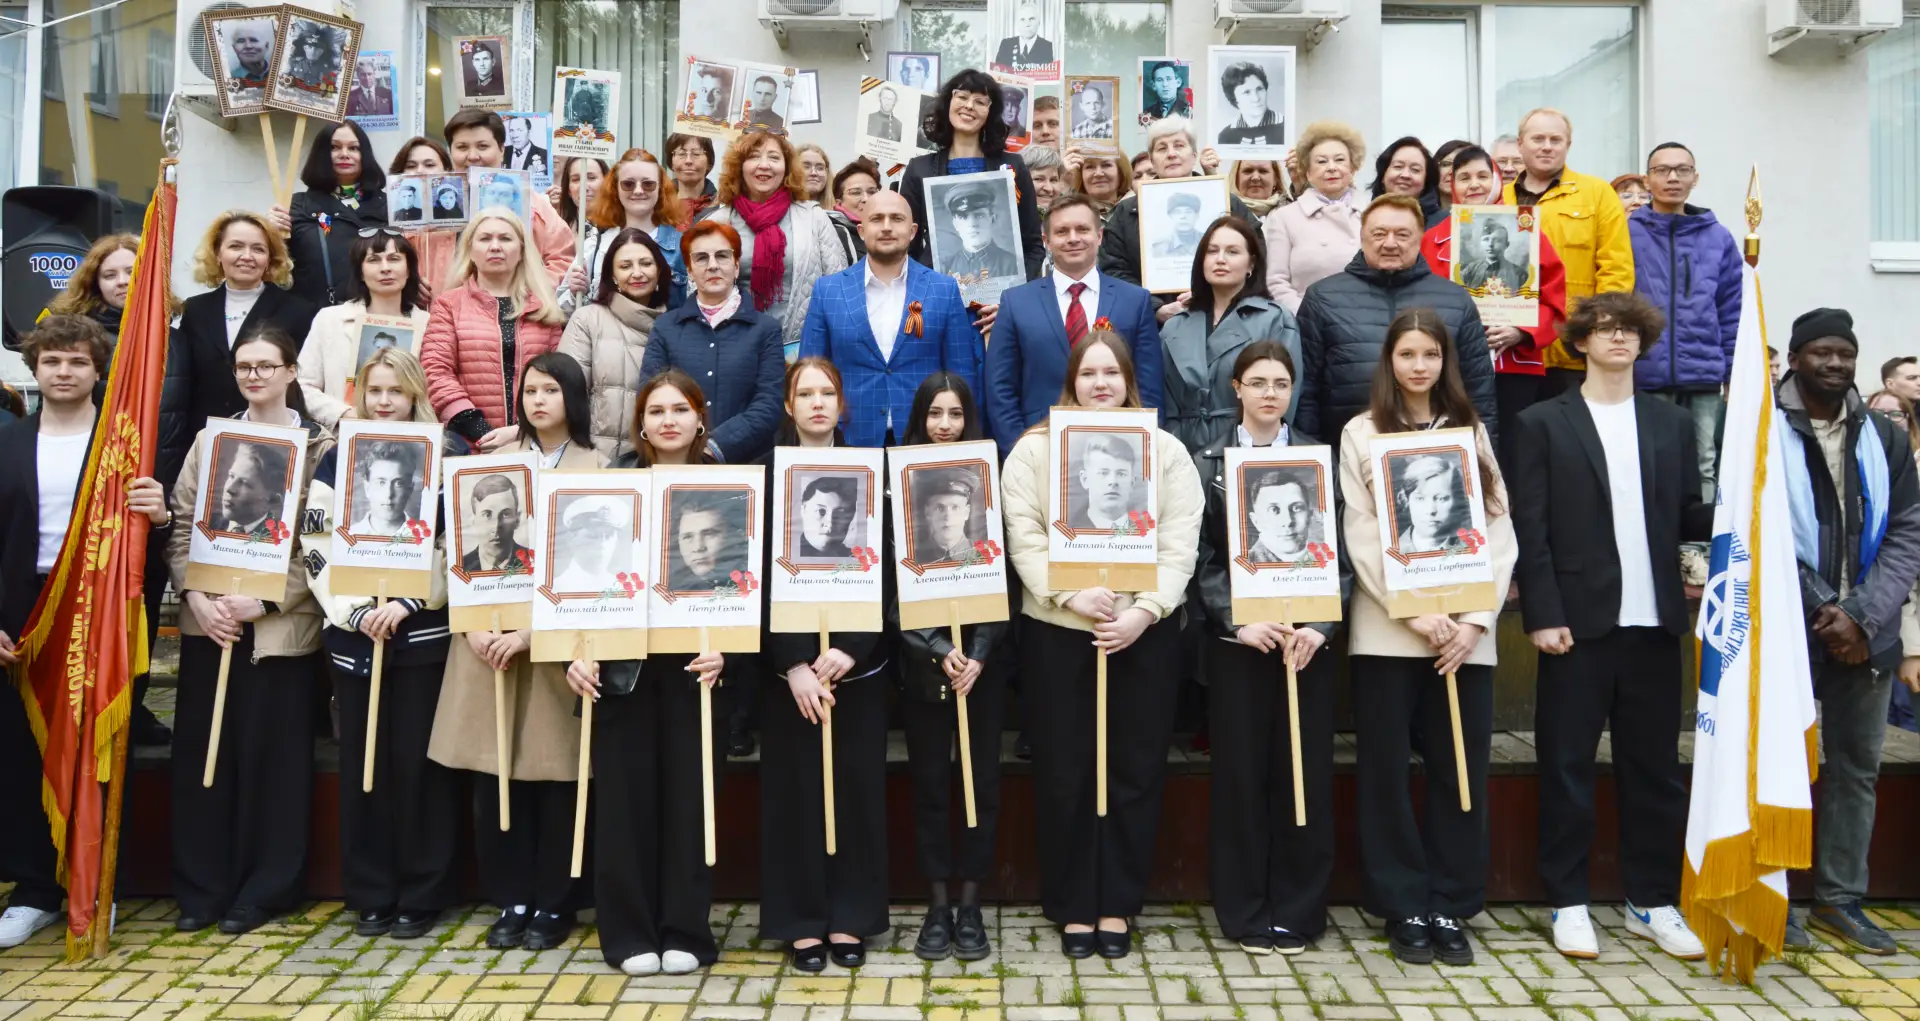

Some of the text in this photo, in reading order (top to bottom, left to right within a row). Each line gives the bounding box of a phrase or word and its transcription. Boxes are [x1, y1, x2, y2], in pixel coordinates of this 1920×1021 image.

[1013, 62, 1058, 72] КУЗЬМИН
[29, 255, 78, 273] 1000
[210, 543, 283, 560] Михаил Кулагин
[347, 547, 422, 559] Георгий Мендрин
[912, 573, 961, 585] Александр
[473, 584, 495, 592] Иван
